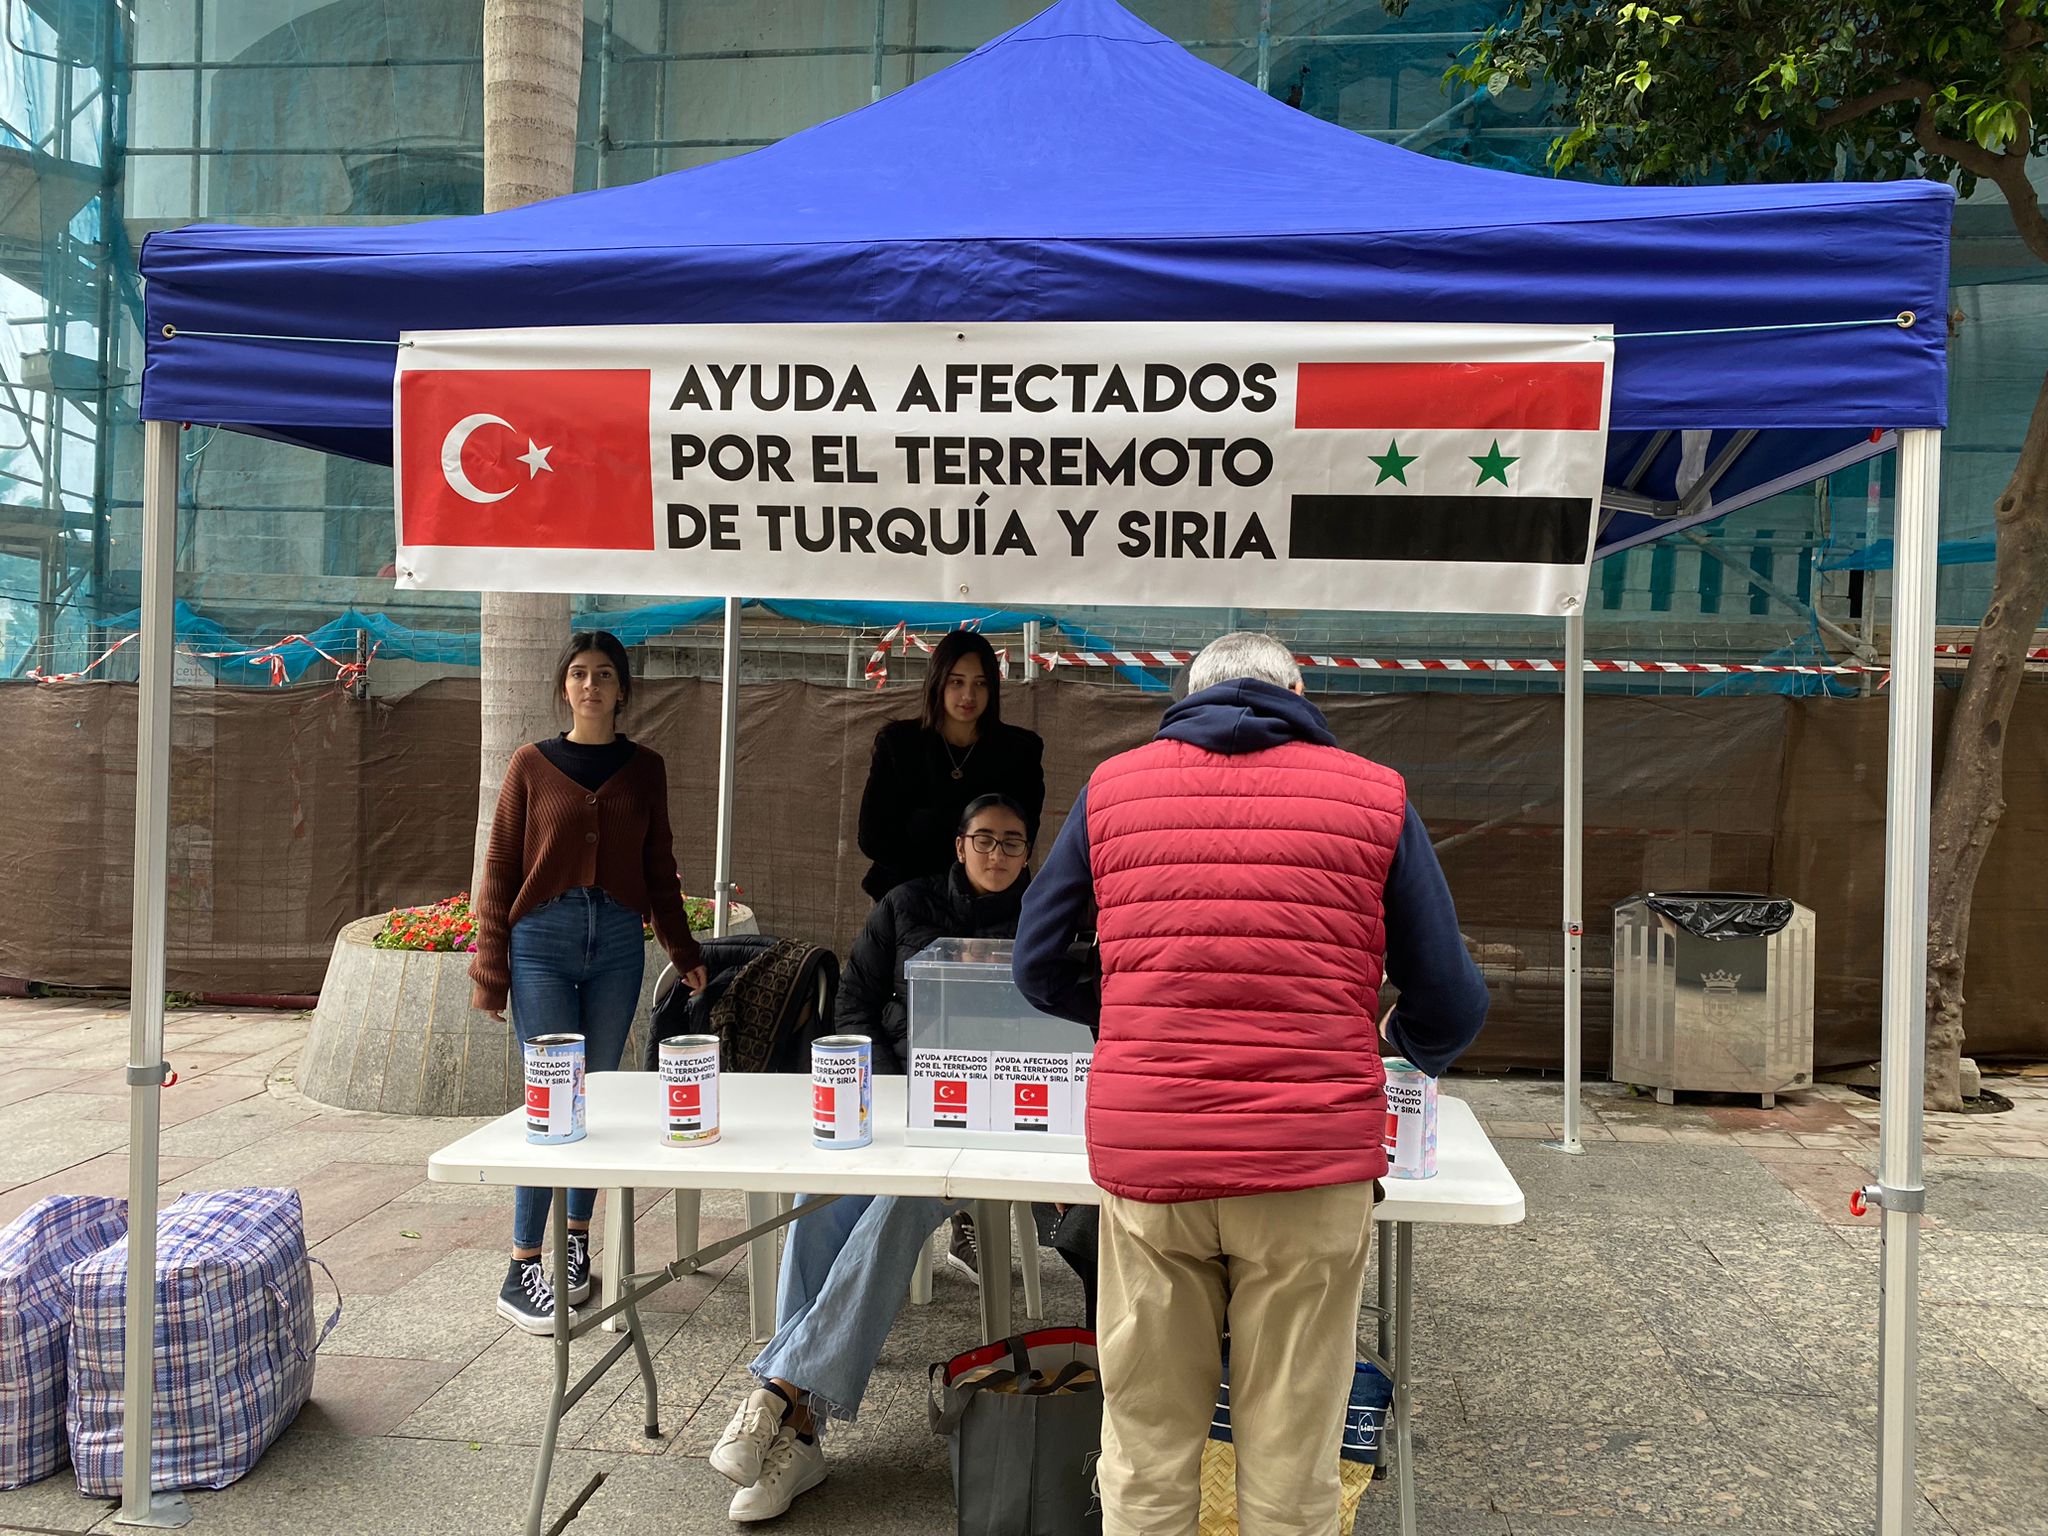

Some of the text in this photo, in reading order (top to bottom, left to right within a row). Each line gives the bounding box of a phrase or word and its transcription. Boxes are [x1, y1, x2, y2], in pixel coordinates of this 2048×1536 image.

[670, 363, 1277, 413] AYUDA AFECTADOS
[671, 434, 1274, 487] POR EL TERREMOTO
[667, 491, 1277, 560] DE TURQUÍA Y SIRIA
[675, 1056, 715, 1066] AFECTADOS
[943, 1055, 988, 1063] AFECTADOS
[1023, 1058, 1068, 1066] AFECTADOS
[675, 1064, 715, 1074] TERREMOTO
[943, 1063, 988, 1071] TERREMOTO
[1023, 1066, 1068, 1074] TERREMOTO
[530, 1068, 570, 1076] TERREMOTO
[926, 1070, 960, 1078] TURQUÍA
[1006, 1073, 1040, 1081] TURQUÍA
[1401, 1106, 1421, 1114] SIRIA
